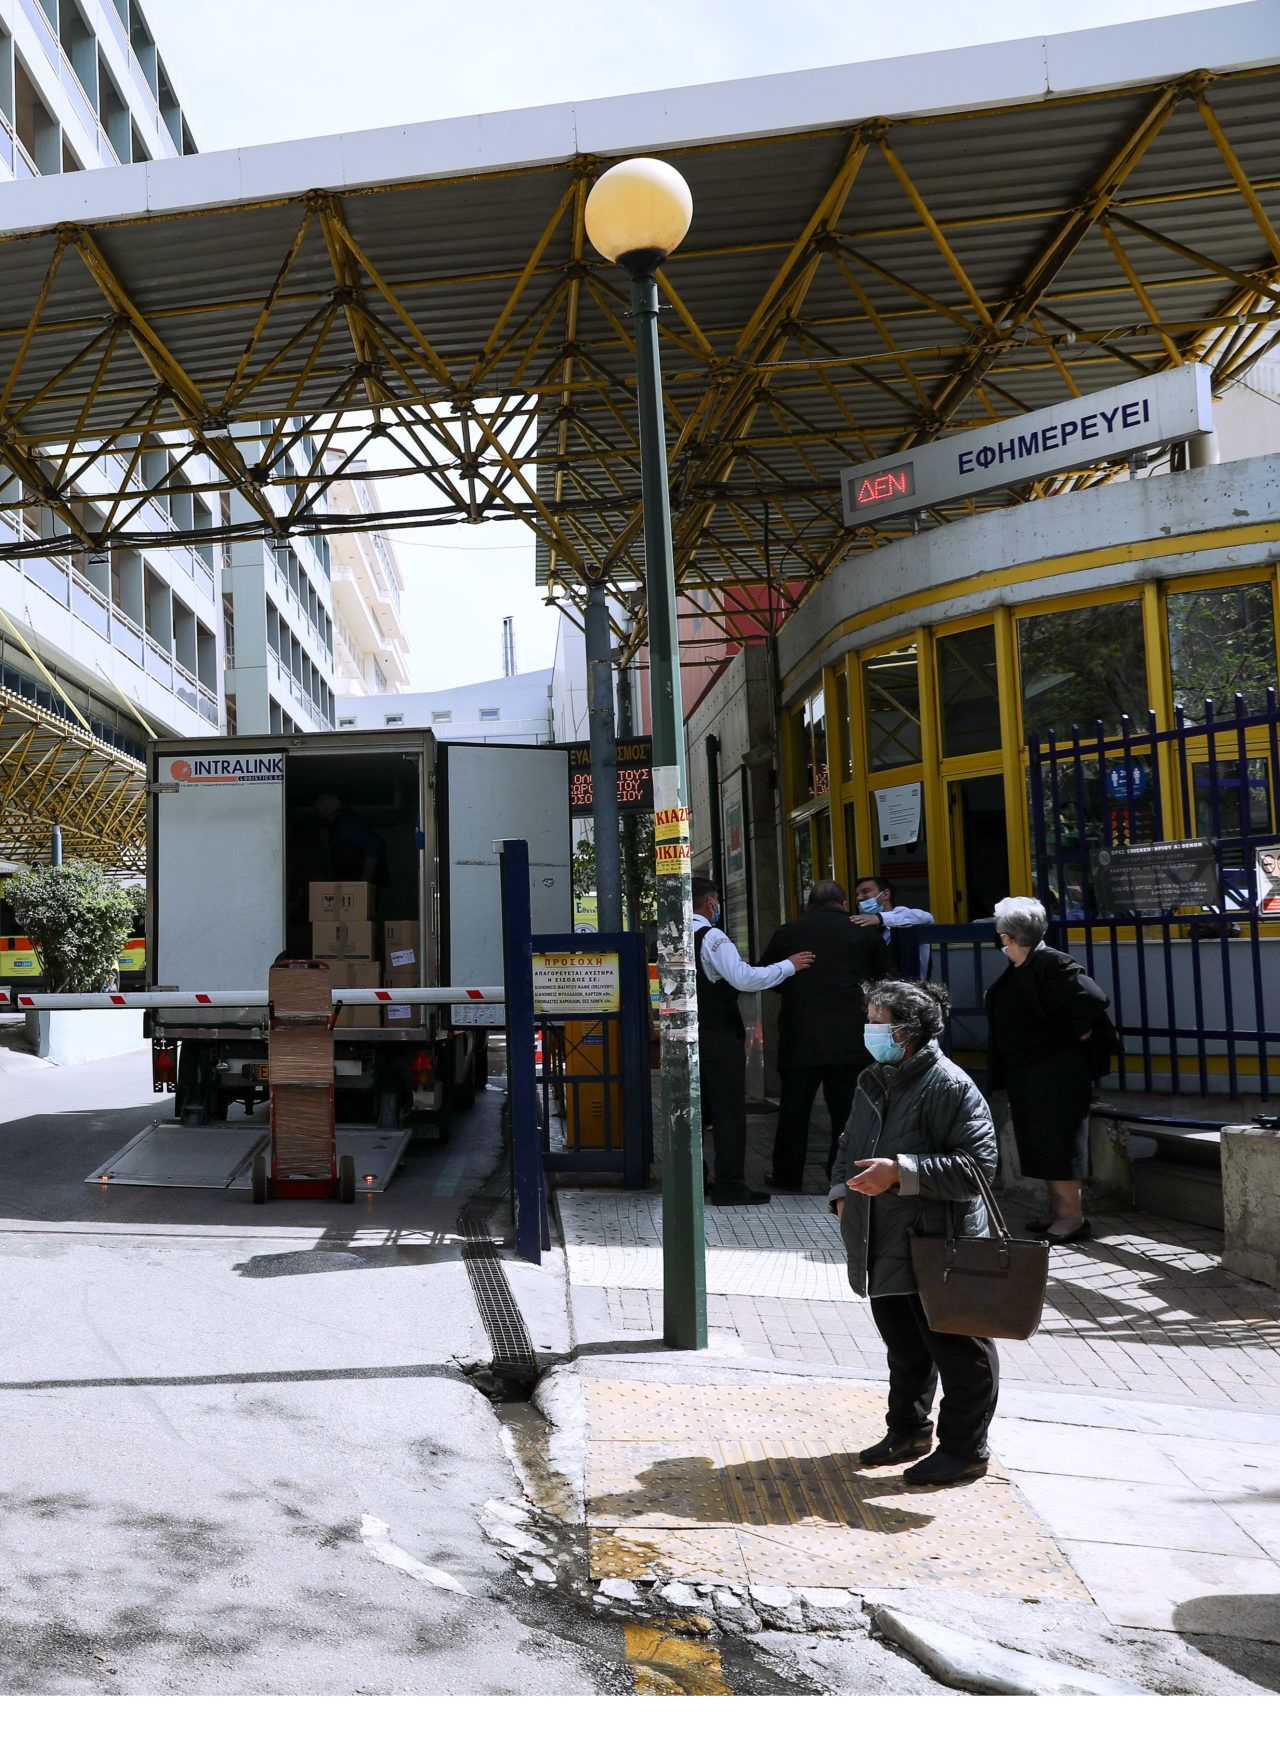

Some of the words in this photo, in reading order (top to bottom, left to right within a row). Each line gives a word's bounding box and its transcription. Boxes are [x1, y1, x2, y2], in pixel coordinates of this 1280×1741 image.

[958, 399, 1150, 475] ΕΦΗΜΕΡΕΥΕΙ
[858, 472, 907, 503] ΔΕΝ
[194, 759, 283, 775] INTRALINK
[617, 768, 649, 781] ΤΟΥΣ
[545, 958, 603, 967] ΠΡΟΣΟΧΗ
